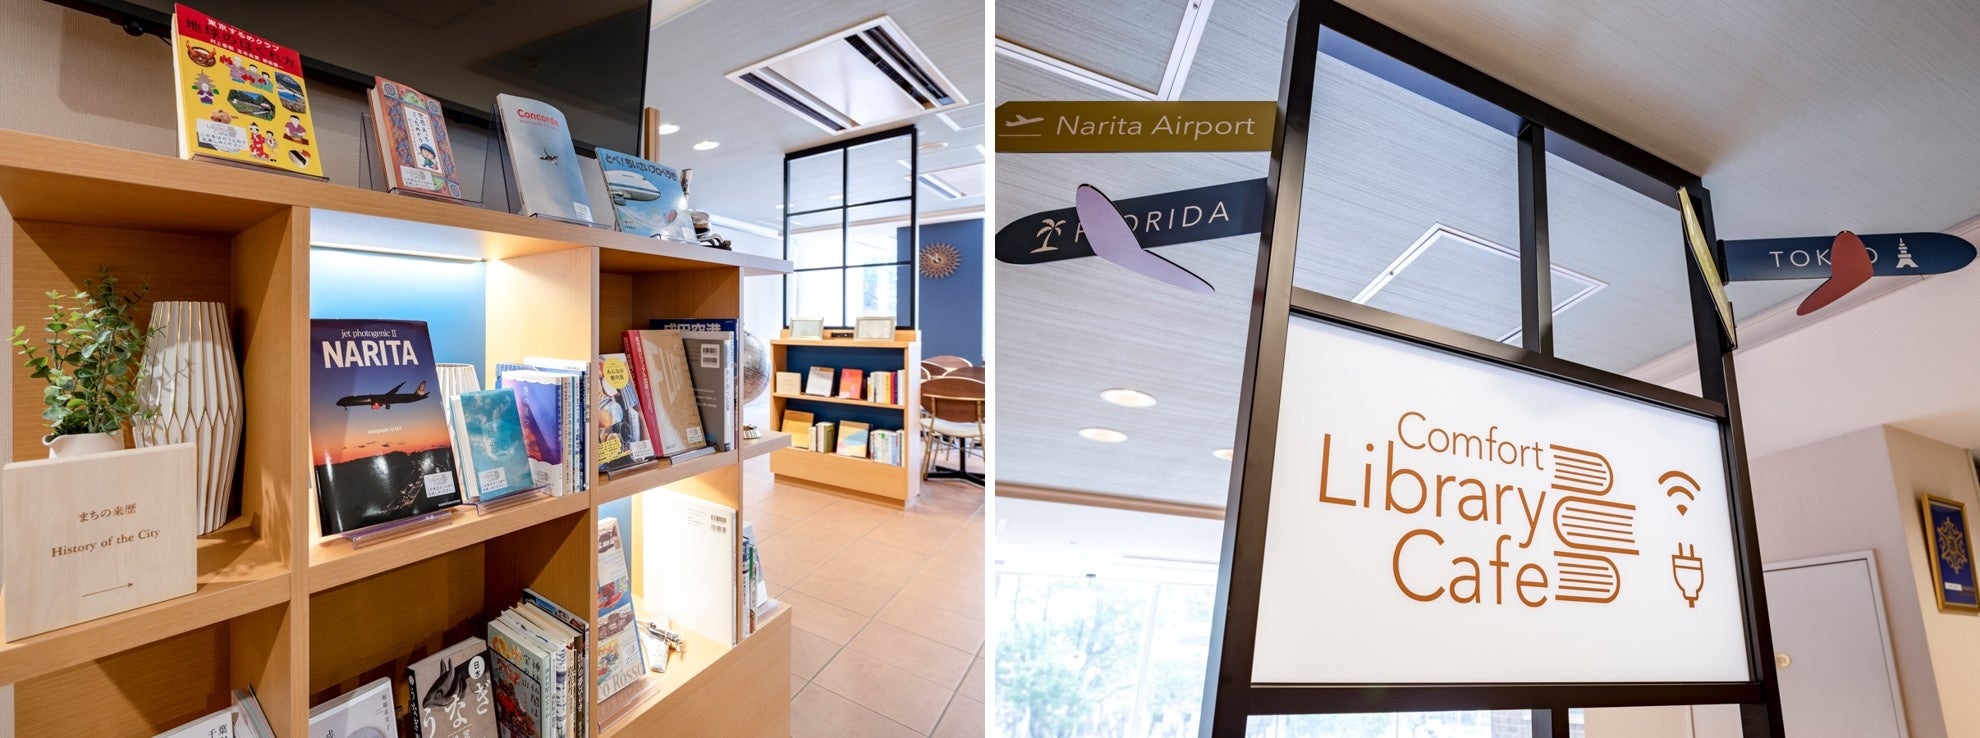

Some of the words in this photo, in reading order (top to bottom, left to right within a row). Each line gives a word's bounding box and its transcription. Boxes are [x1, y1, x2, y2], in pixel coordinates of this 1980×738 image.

[207, 18, 280, 52] 東京するめクラブ
[1056, 115, 1142, 135] Narita
[1151, 115, 1255, 140] Airport
[1074, 201, 1230, 243] FRIDA
[1768, 249, 1879, 268] TOK
[341, 329, 351, 338] jet
[353, 330, 390, 339] photogenic
[321, 340, 419, 369] NARITA
[1398, 411, 1544, 471] Comfort
[1319, 433, 1546, 549] Library
[79, 503, 137, 523] まちの来歴
[51, 541, 97, 558] History
[101, 536, 114, 548] of
[117, 535, 134, 545] the
[138, 529, 161, 539] City
[1392, 528, 1548, 608] Cafe
[473, 661, 481, 677] 日本
